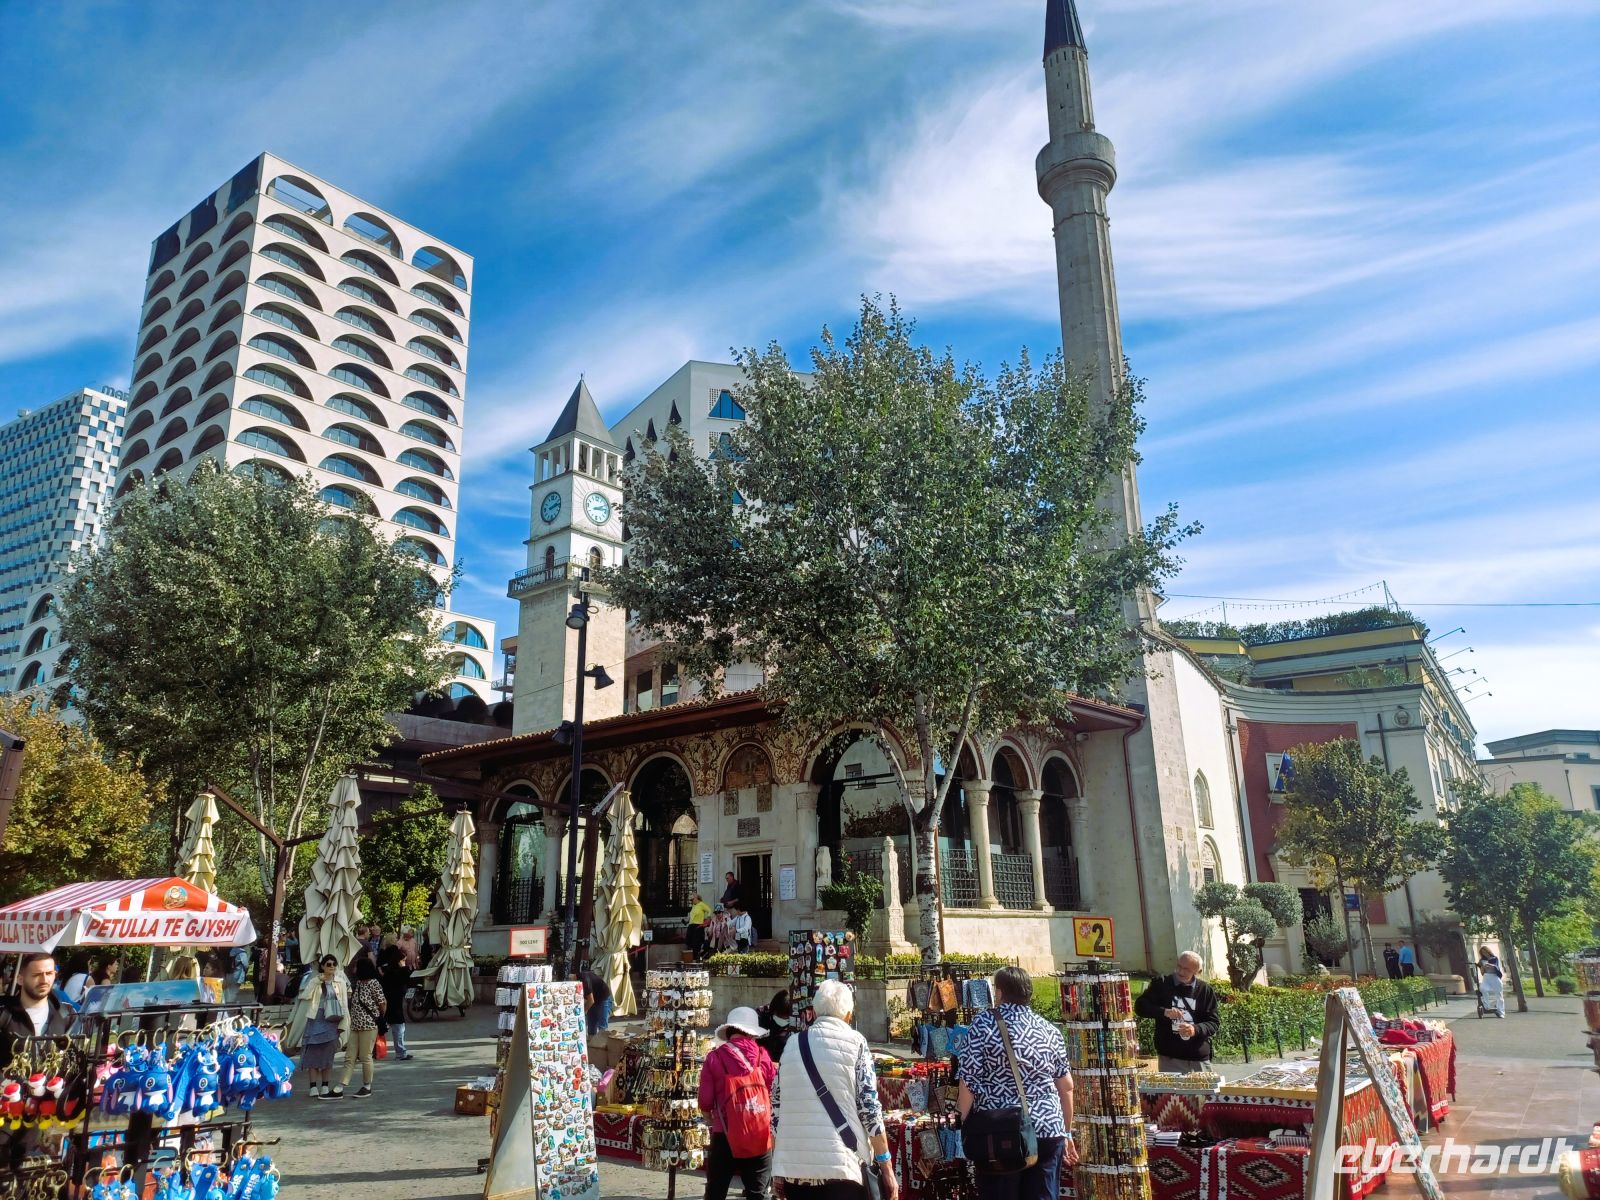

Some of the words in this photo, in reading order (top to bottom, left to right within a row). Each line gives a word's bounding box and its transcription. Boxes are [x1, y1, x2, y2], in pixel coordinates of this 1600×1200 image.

[0, 923, 19, 943] LLA
[21, 923, 35, 944] TE
[85, 918, 160, 938] PETULLA
[163, 918, 184, 937] TE
[185, 919, 240, 938] GJYSHI
